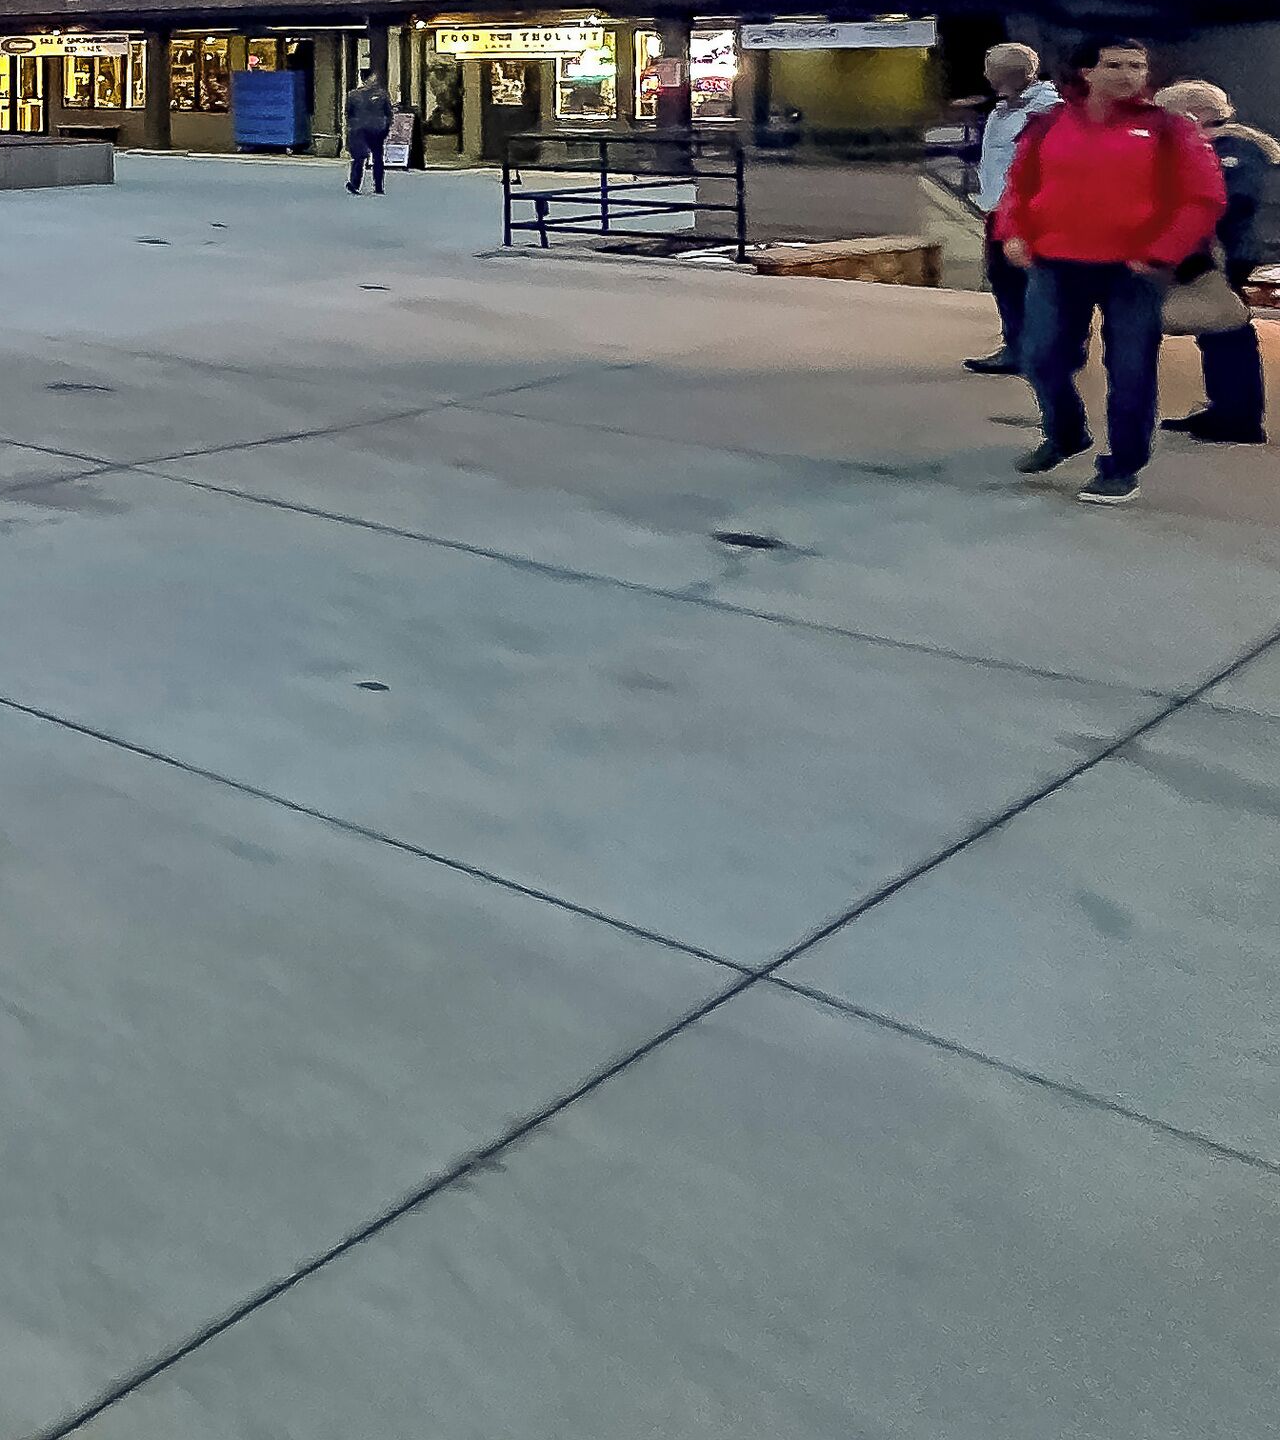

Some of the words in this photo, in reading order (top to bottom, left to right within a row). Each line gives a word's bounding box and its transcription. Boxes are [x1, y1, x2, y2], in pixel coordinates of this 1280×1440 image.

[40, 37, 53, 45] SKI
[57, 37, 64, 45] &
[441, 34, 480, 43] FOOD
